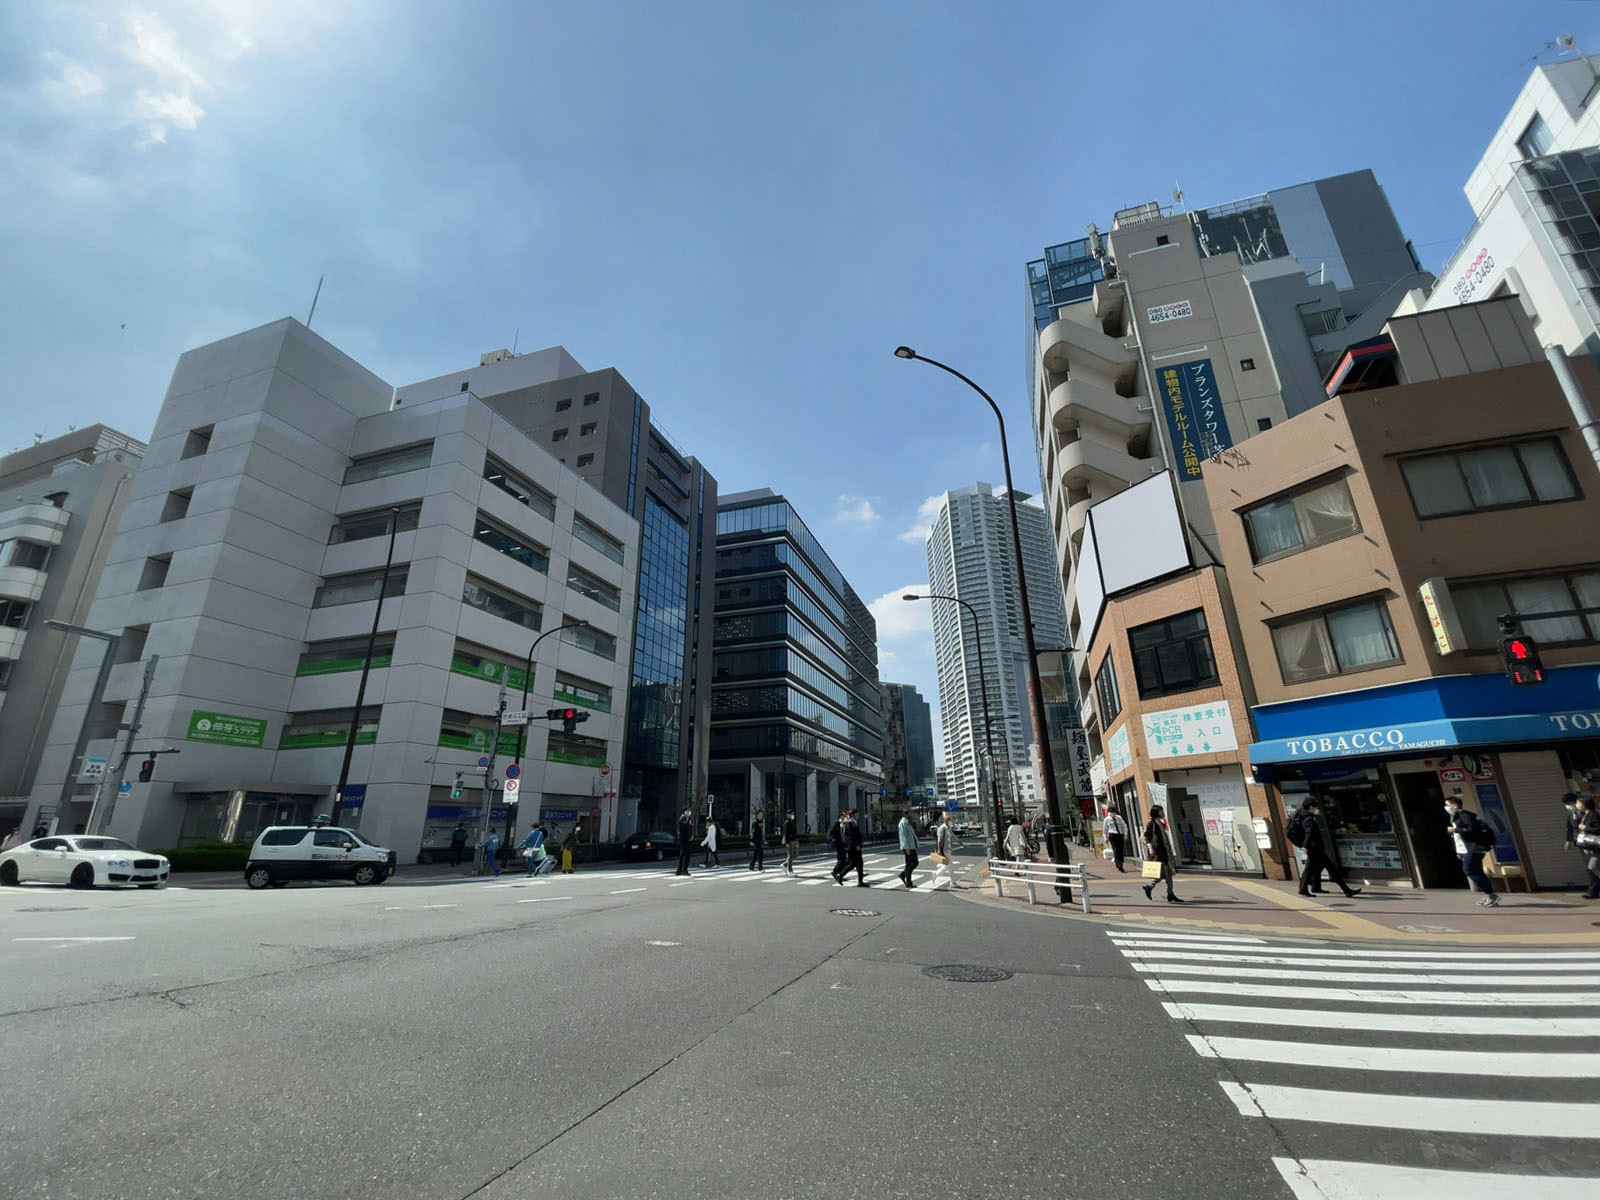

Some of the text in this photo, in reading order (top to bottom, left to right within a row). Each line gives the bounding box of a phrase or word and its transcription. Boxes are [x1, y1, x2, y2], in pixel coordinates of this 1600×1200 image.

[1163, 369, 1201, 476] 建物内モデルルーム公開中
[1183, 707, 1226, 722] 検査受付
[1162, 725, 1182, 735] PCR
[1198, 726, 1221, 737] 入口
[1287, 729, 1404, 755] TOBACCO
[1398, 739, 1446, 750] YAMAGUCHI
